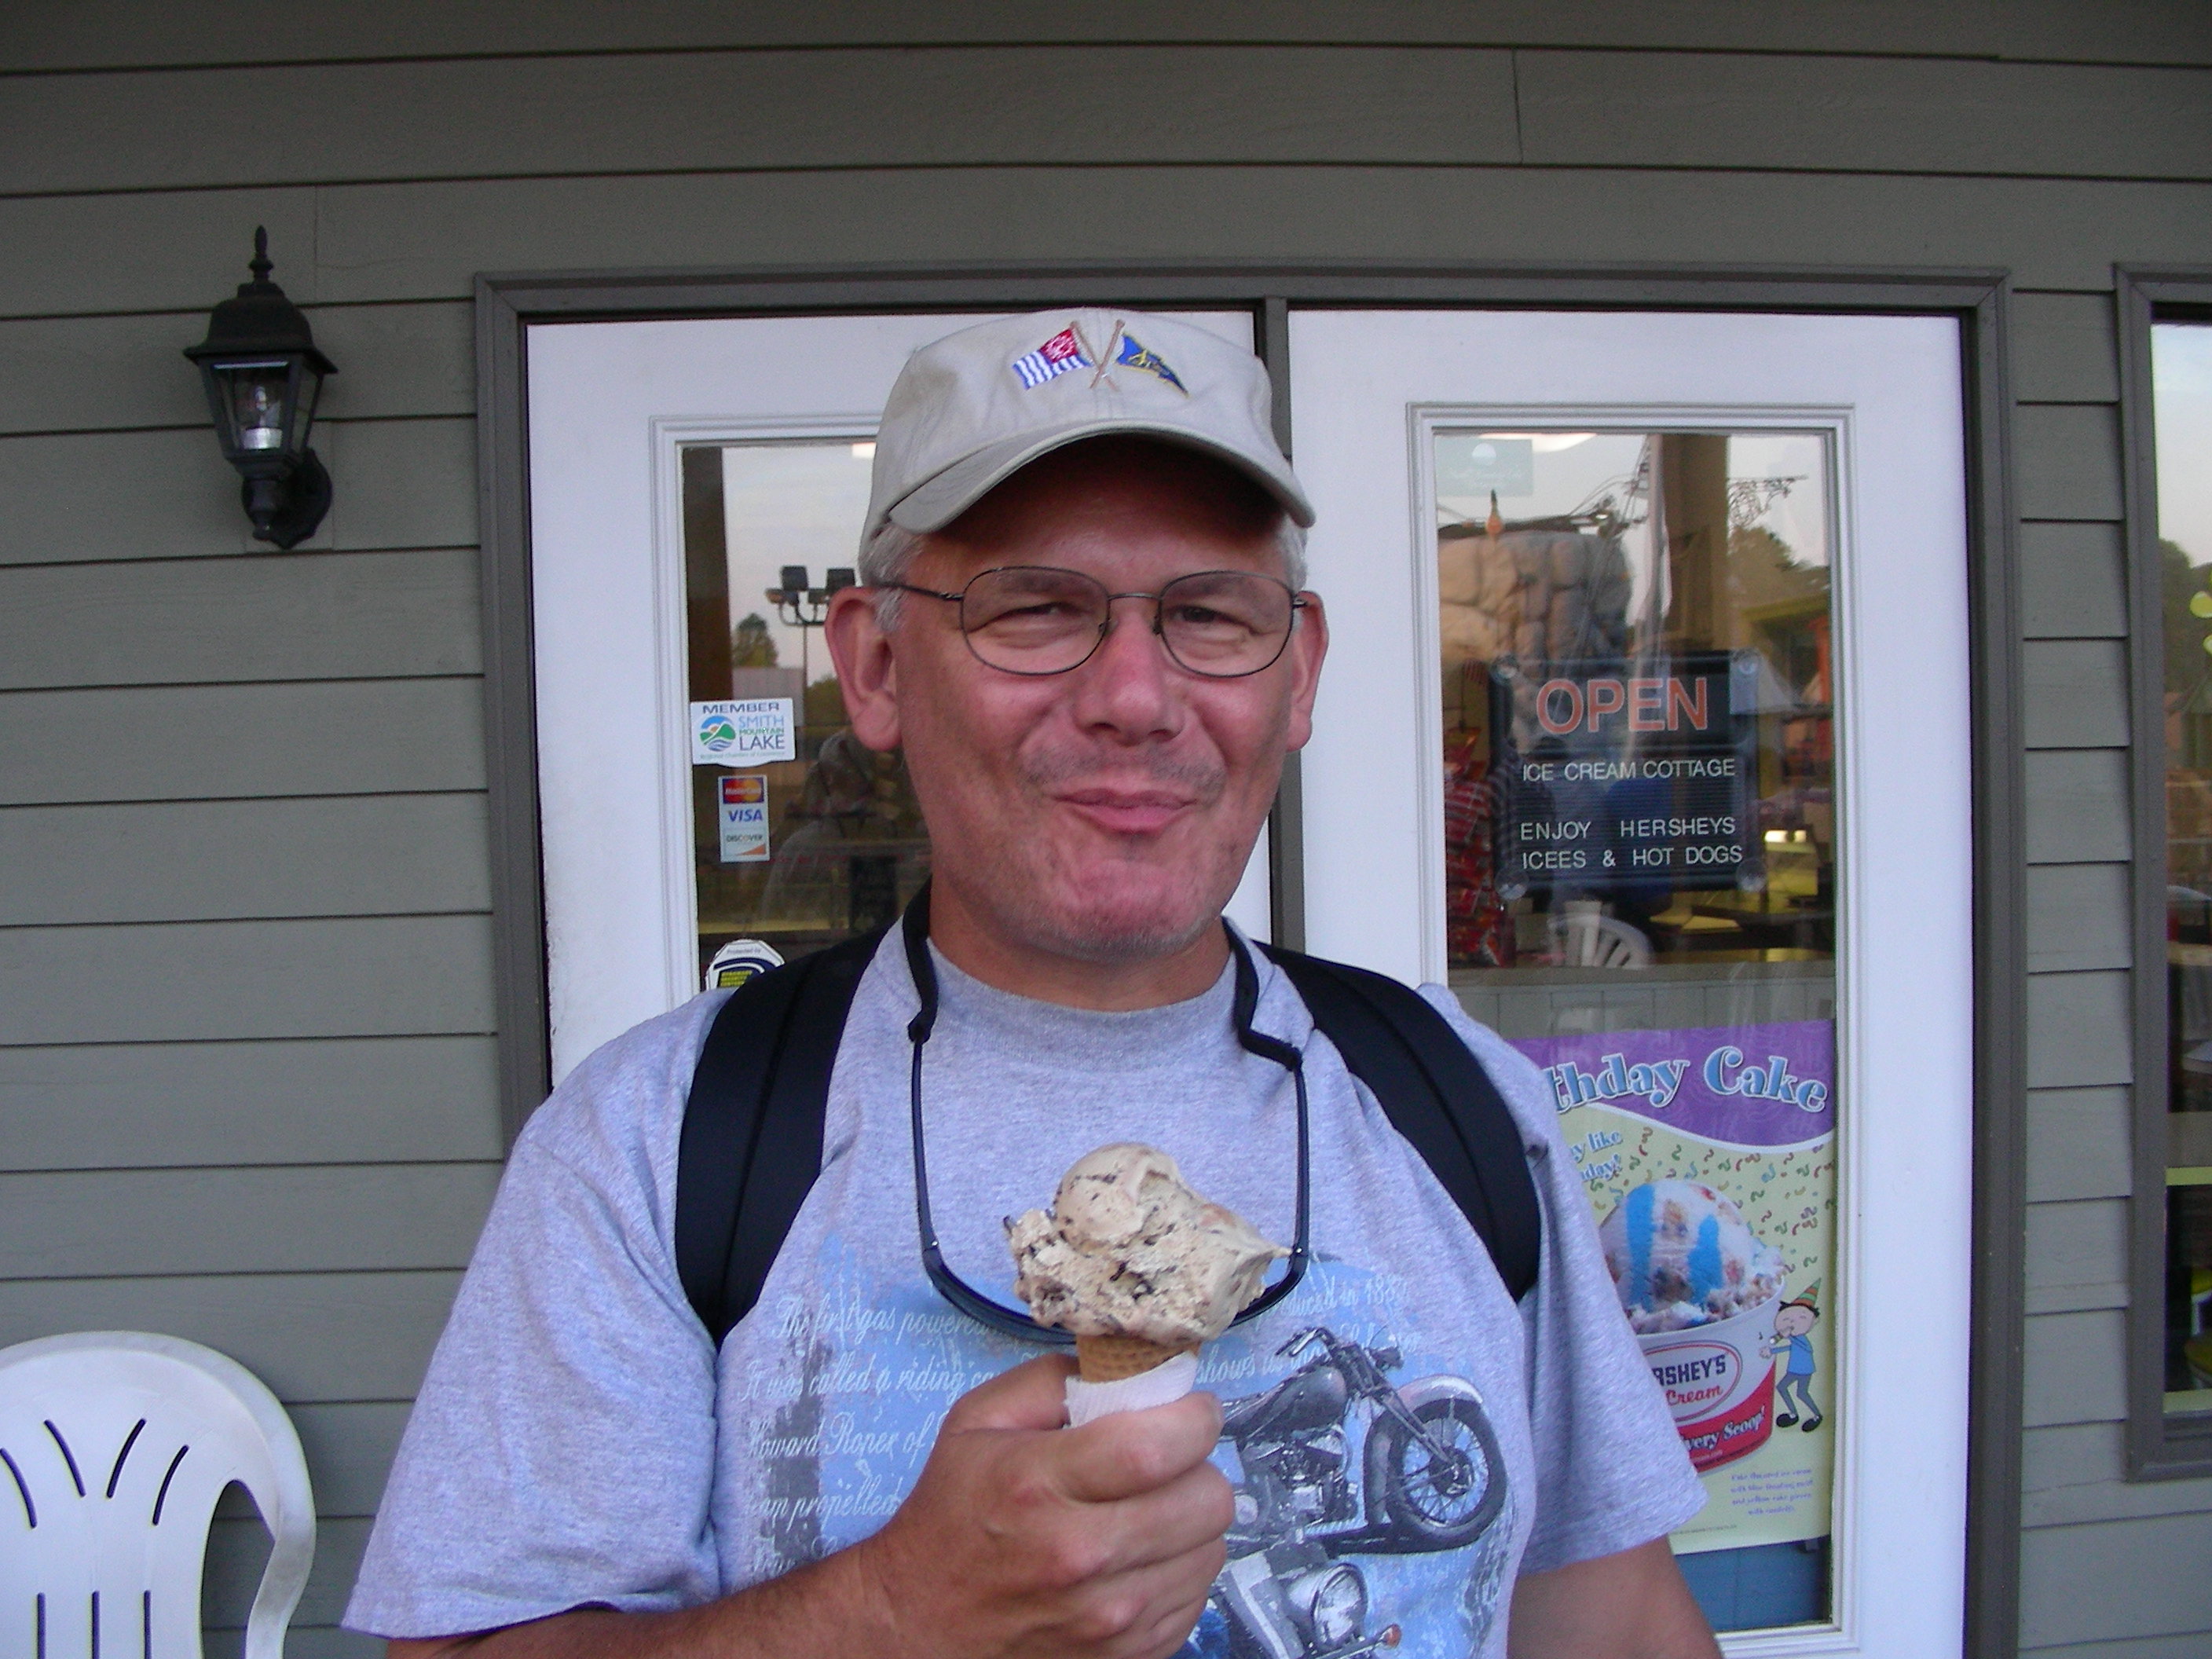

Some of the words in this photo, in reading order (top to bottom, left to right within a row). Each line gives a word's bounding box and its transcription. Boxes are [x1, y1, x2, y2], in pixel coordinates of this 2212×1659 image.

[702, 701, 780, 714] MEMBER
[1536, 677, 1708, 734] OPEN
[738, 715, 785, 728] SMITH
[738, 734, 786, 752] LAKE
[1522, 764, 1555, 782] ICE
[1564, 761, 1637, 781] CREAM
[1643, 759, 1736, 778] COTTAGE
[728, 810, 763, 822] VISA
[726, 833, 764, 842] DISCOVER
[1521, 822, 1591, 840] ENJOY
[1620, 817, 1736, 837] HERSHEYS
[1522, 851, 1587, 870] ICEES
[1602, 850, 1617, 867] &
[1632, 848, 1675, 866] HOT
[1685, 845, 1744, 865] DOGS
[1542, 1052, 1690, 1115] thday
[1703, 1045, 1829, 1113] Cake
[1587, 1130, 1624, 1152] like
[772, 1293, 810, 1339] The
[854, 1306, 896, 1346] gas
[808, 1350, 877, 1397] called
[895, 1354, 966, 1406] riding
[1651, 1353, 1727, 1387] RSHEY'S
[1666, 1385, 1723, 1407] Cream
[747, 1416, 824, 1459] Howard
[903, 1411, 936, 1469] of
[1683, 1431, 1721, 1452] very
